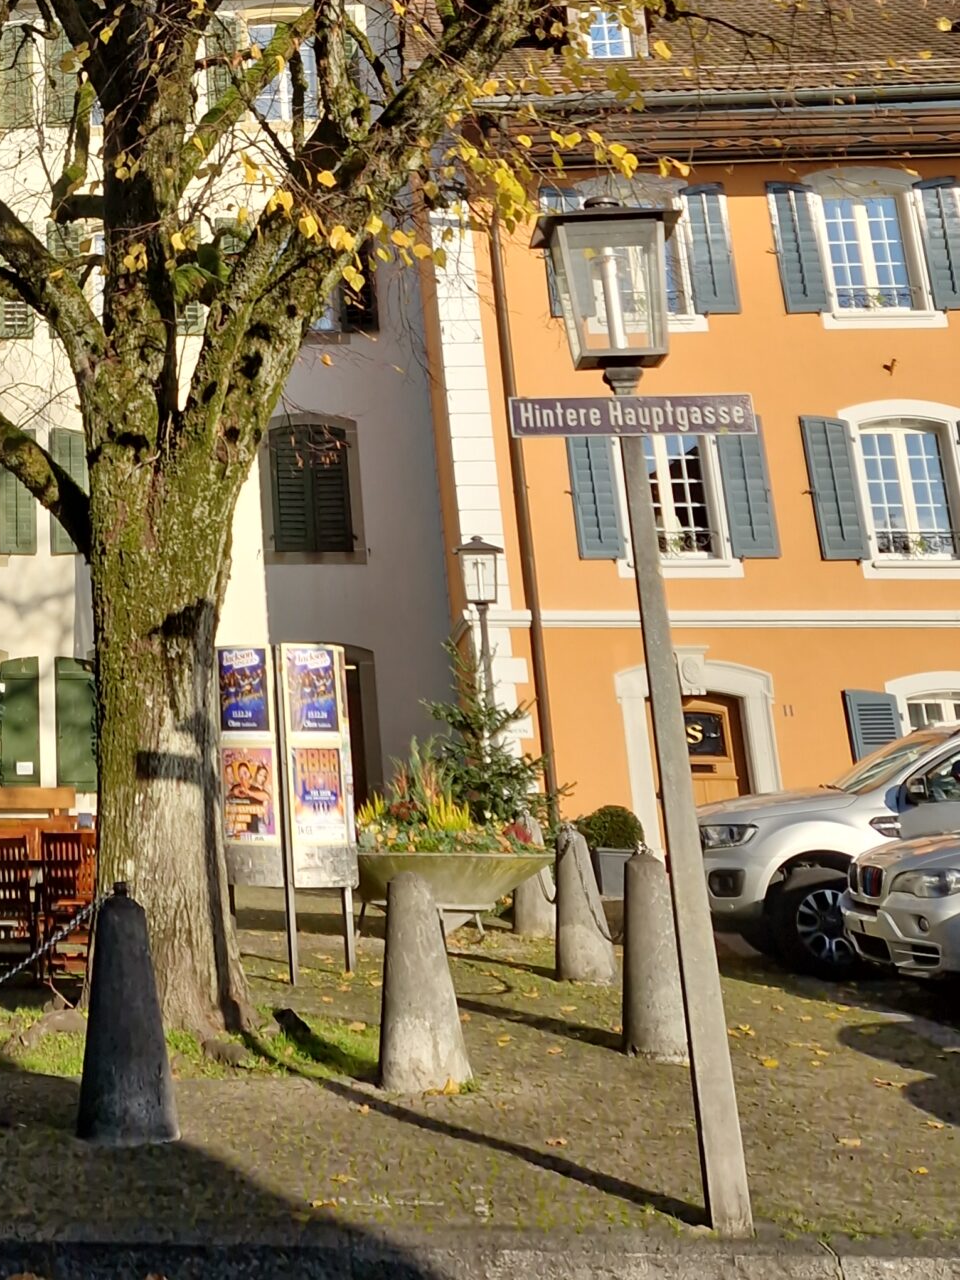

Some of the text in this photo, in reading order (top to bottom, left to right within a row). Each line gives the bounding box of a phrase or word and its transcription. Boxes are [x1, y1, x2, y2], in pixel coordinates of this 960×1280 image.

[519, 400, 745, 432] Hintere Hauptgasse
[225, 651, 254, 663] Jackson
[295, 748, 339, 773] ABBA
